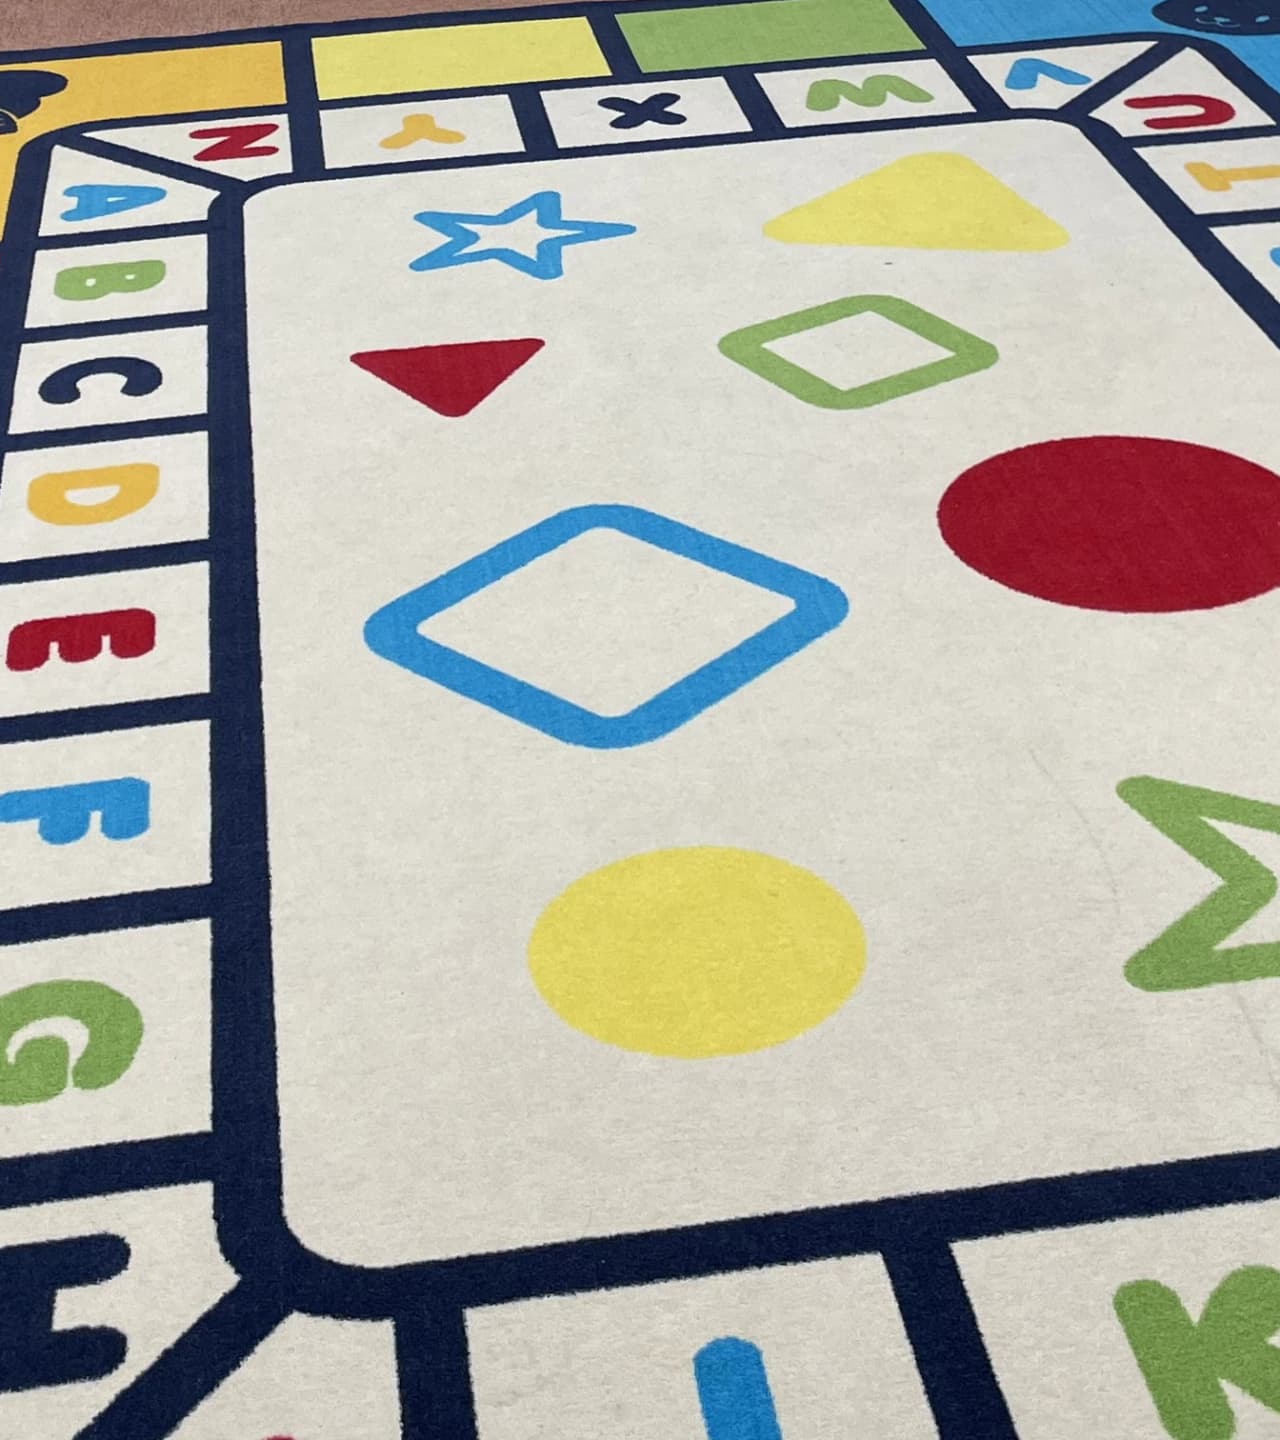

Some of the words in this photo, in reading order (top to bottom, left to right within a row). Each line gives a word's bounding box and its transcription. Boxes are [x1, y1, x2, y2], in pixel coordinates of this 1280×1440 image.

[1005, 58, 1092, 91] V
[597, 91, 687, 129] X
[1122, 92, 1237, 130] U
[188, 123, 280, 162] Z
[379, 113, 466, 149] Y
[59, 183, 167, 222] A
[54, 259, 167, 302] B
[38, 355, 163, 404] C
[26, 462, 161, 526] D
[6, 607, 157, 672] E
